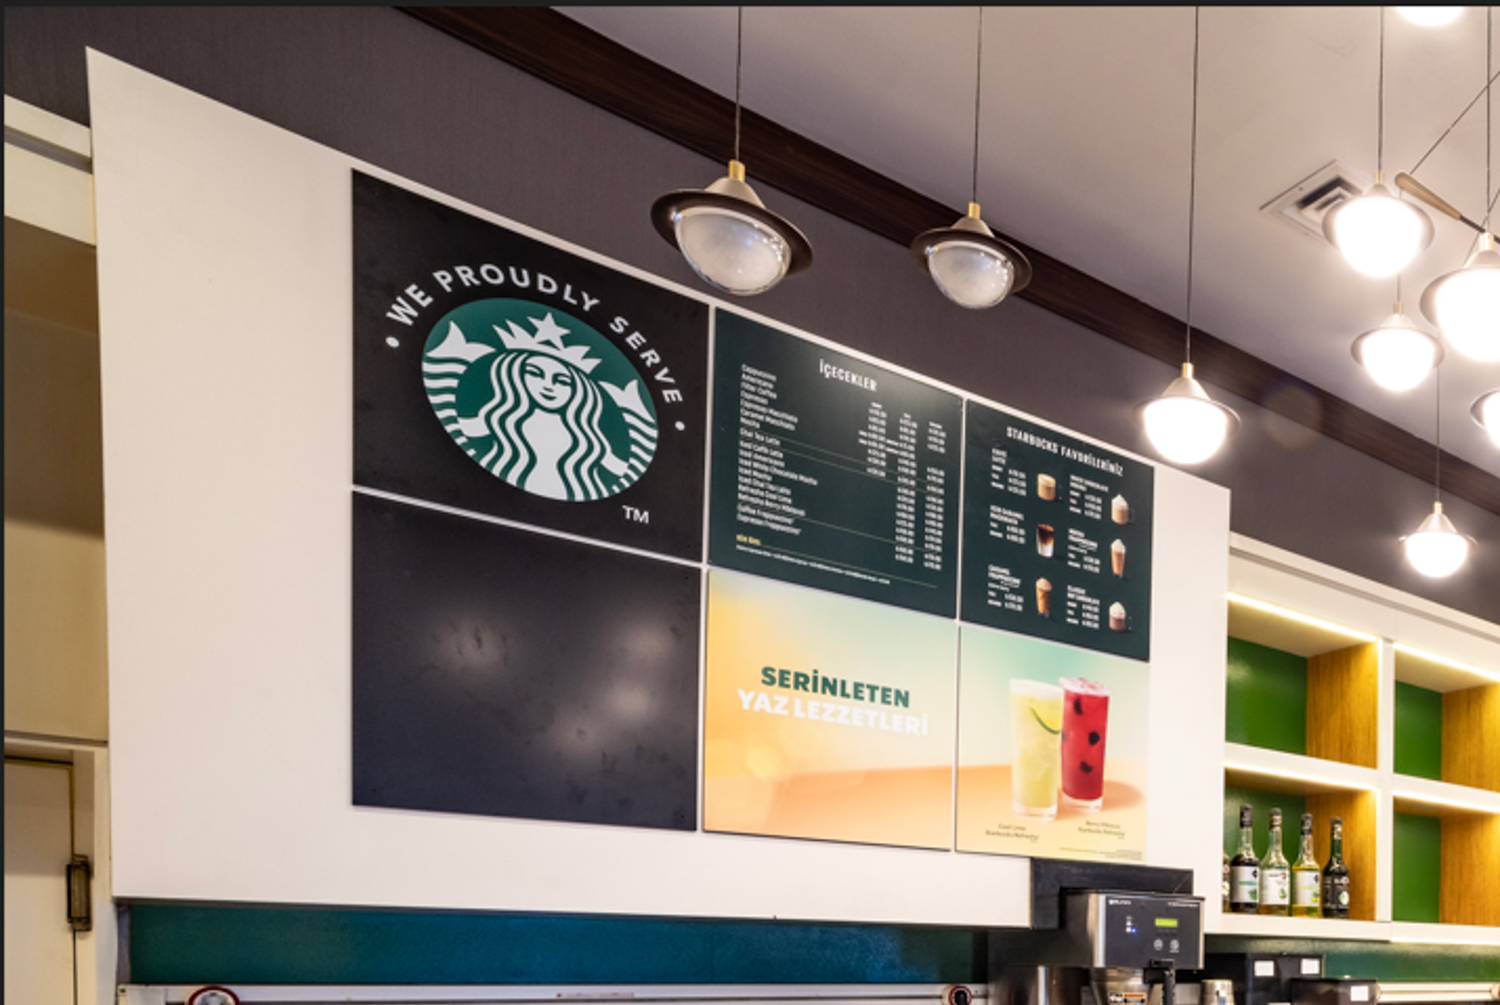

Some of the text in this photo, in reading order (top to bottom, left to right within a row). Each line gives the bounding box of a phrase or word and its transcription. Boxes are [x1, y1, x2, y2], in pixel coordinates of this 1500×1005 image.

[386, 264, 683, 403] WE PROUDLY SERVE
[622, 505, 649, 523] TM
[761, 666, 910, 708] SERİNLETEN
[737, 689, 928, 736] YAZ LEZZETLERİ
